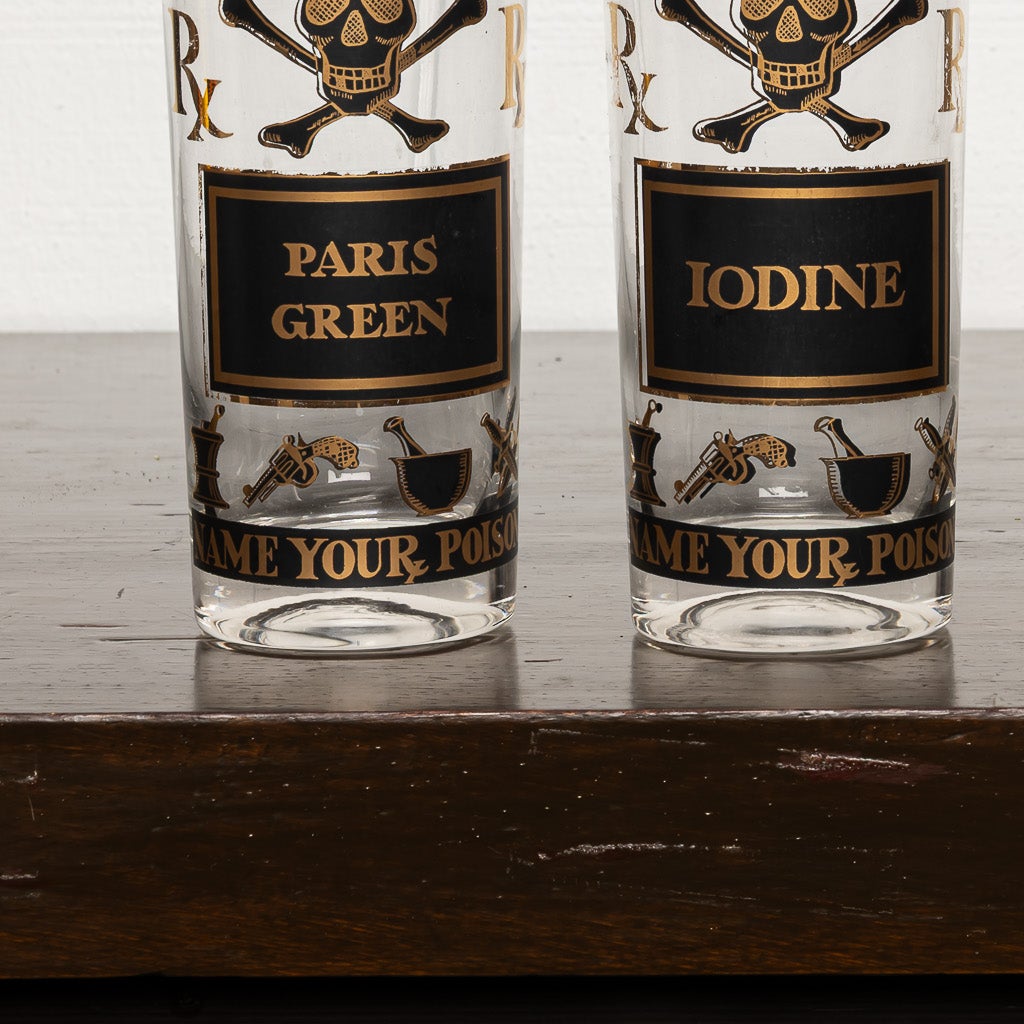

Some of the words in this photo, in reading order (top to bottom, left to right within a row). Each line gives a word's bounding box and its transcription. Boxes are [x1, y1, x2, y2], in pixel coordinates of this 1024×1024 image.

[936, 7, 966, 133] R
[282, 235, 438, 277] PARIS
[685, 260, 906, 311] IODINE
[271, 297, 452, 340] GREEN
[193, 520, 278, 577] NAME
